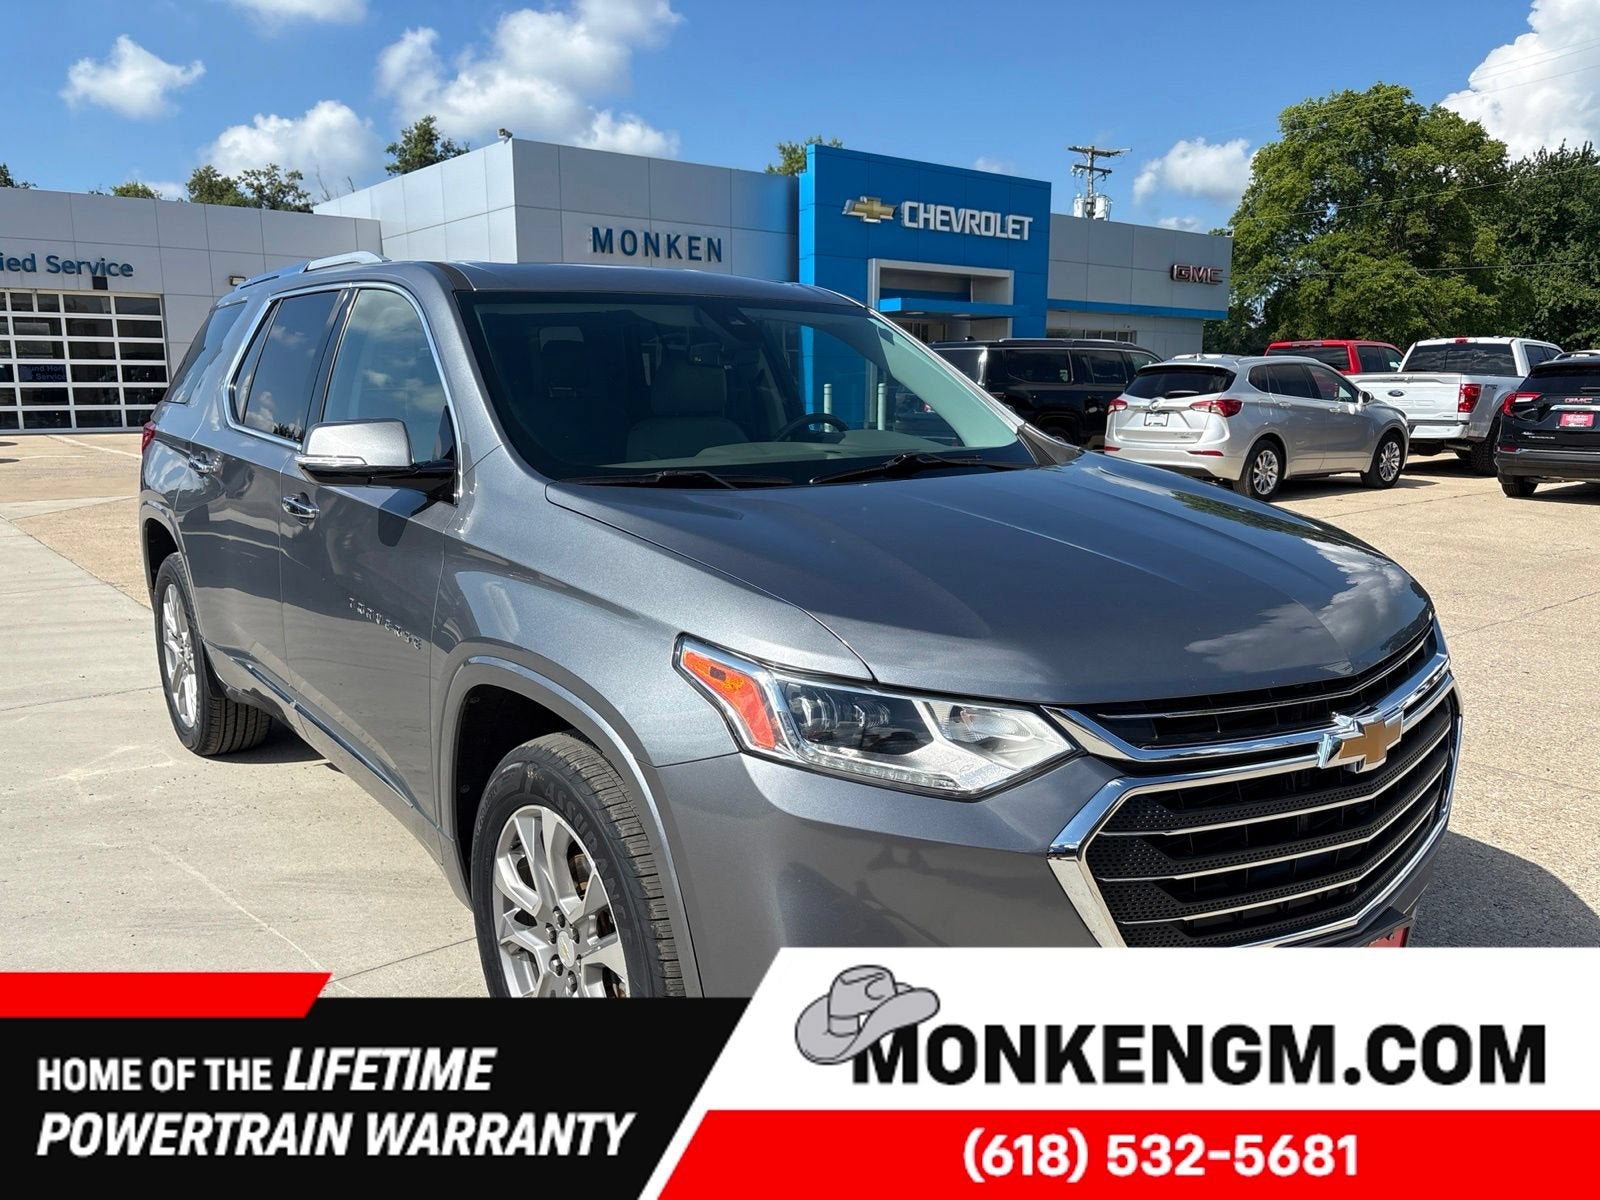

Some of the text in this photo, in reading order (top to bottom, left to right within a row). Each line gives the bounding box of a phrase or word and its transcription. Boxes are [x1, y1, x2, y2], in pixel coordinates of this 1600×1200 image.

[901, 201, 1034, 241] CHEVROLET
[591, 226, 722, 262] MONKEN
[46, 255, 134, 278] Service
[1170, 264, 1224, 285] GMC
